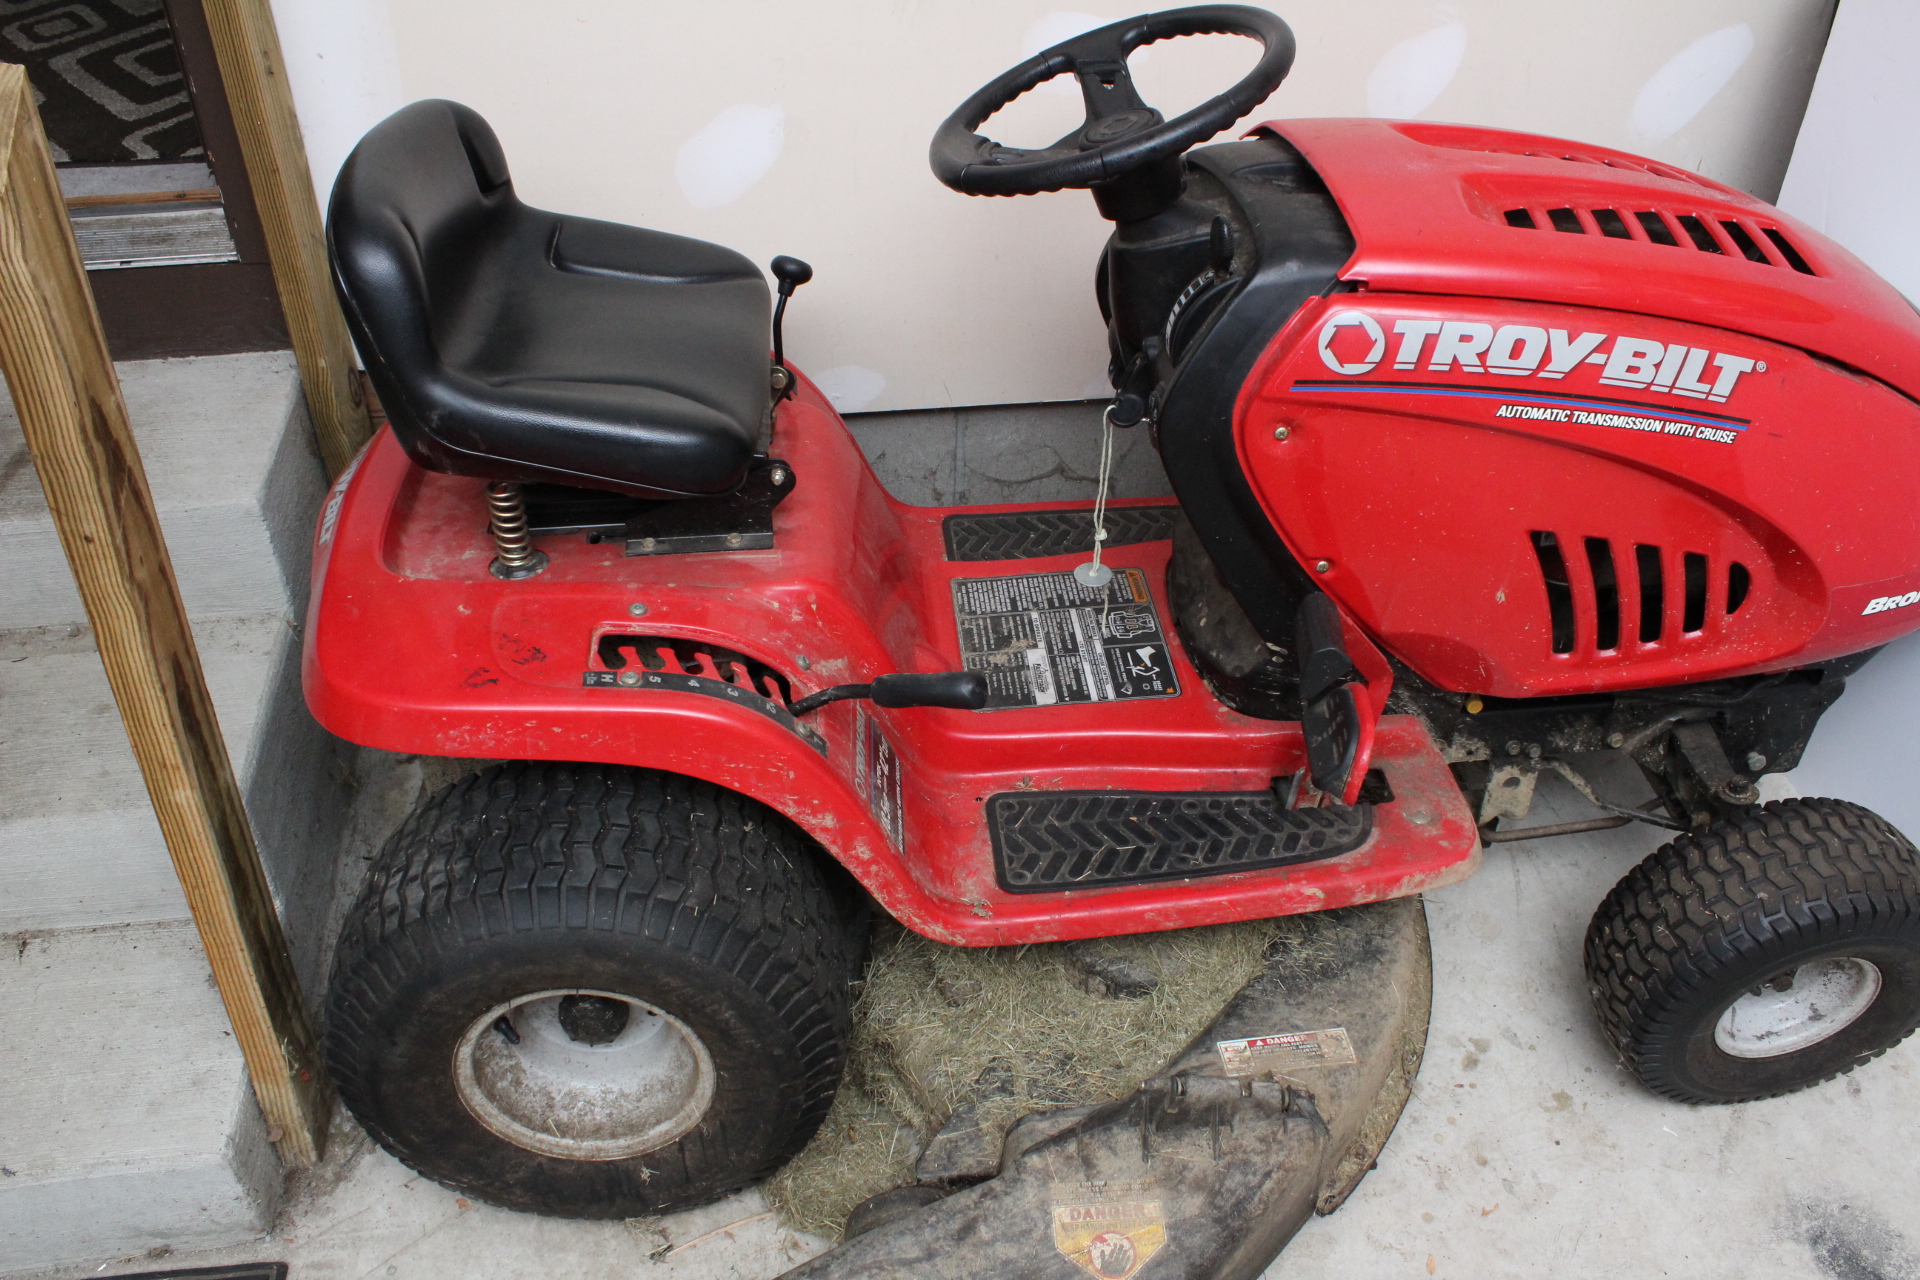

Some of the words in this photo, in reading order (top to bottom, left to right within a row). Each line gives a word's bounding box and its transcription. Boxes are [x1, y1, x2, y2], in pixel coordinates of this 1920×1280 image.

[1496, 405, 1569, 422] AUTOMATIC
[1571, 410, 1664, 433] TRANSMISSION
[1663, 421, 1696, 438] WITH
[1695, 426, 1737, 444] CRUISE
[1034, 623, 1042, 642] OPERATE
[1101, 666, 1109, 685] CONTROL
[600, 674, 614, 683] H
[649, 675, 661, 683] 5
[688, 679, 700, 687] 4
[727, 688, 738, 697] 3
[766, 702, 777, 714] 2
[856, 699, 866, 784] TROY-BILT
[1266, 1034, 1308, 1045] DANGER
[1069, 1202, 1146, 1222] DANGER
